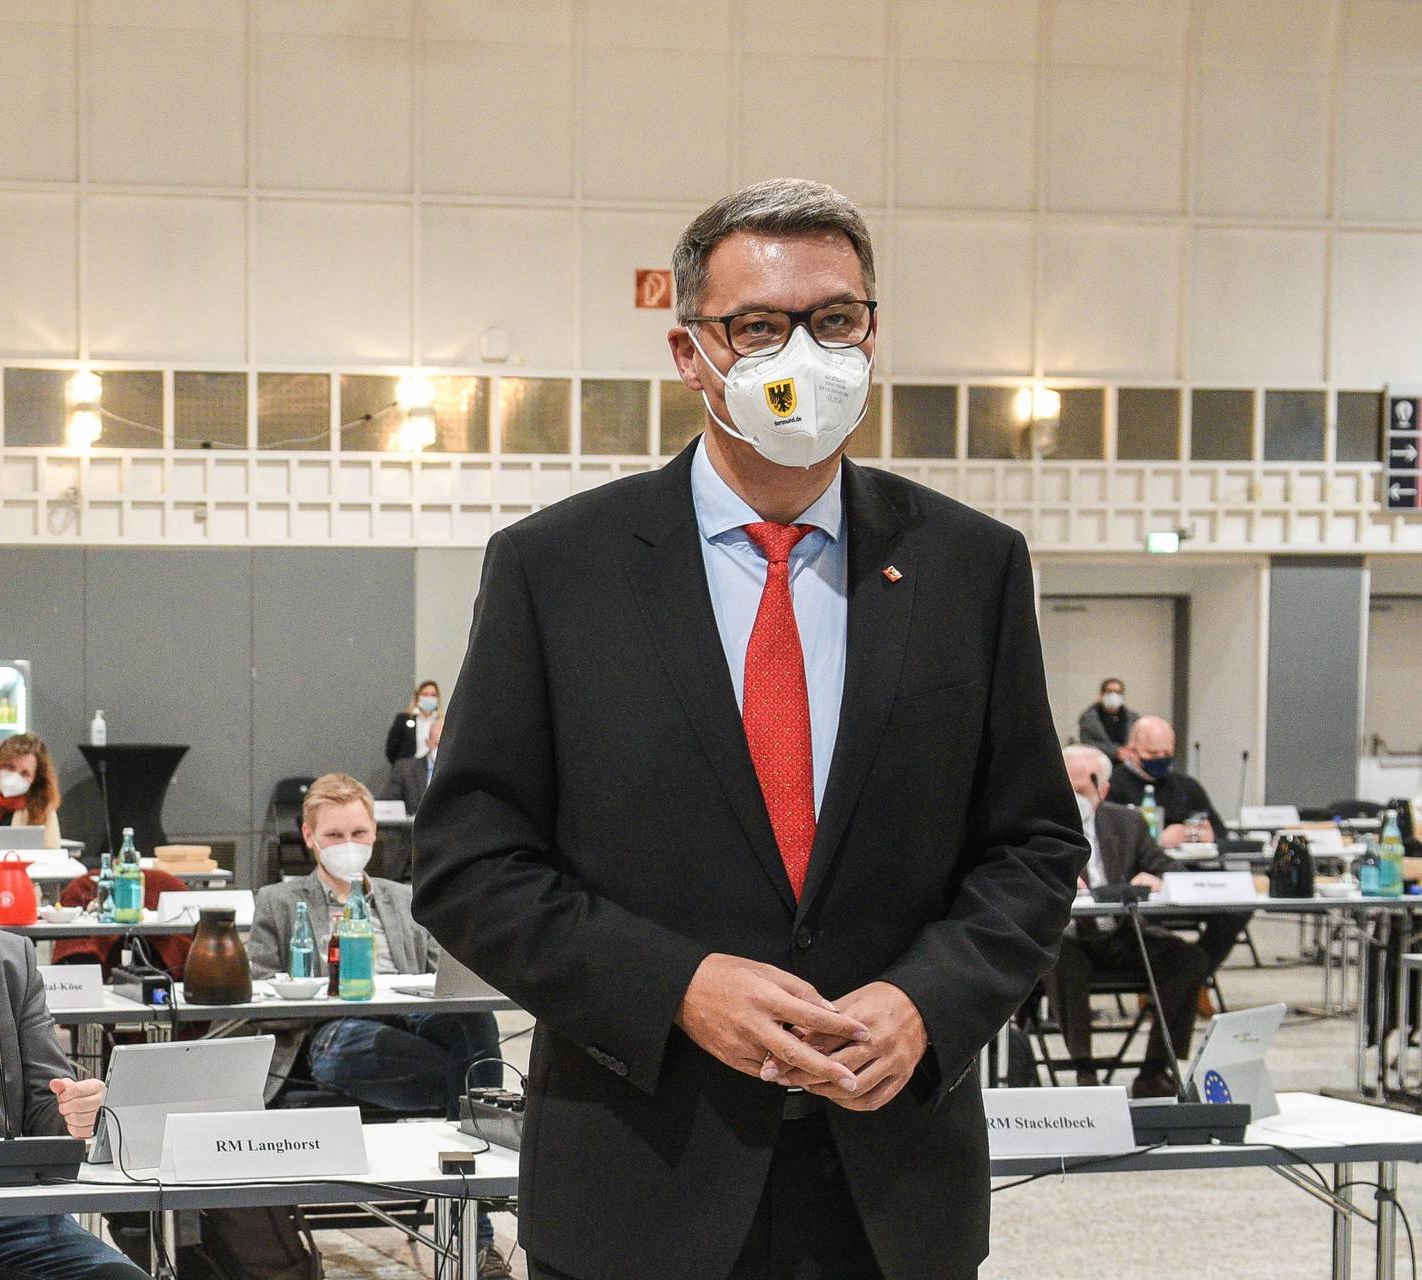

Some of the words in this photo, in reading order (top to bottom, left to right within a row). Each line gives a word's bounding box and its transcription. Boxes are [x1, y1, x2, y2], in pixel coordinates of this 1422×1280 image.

[986, 1117, 1011, 1129] RM
[1014, 1116, 1096, 1129] Stackelbeck
[216, 1139, 243, 1152] RM
[247, 1138, 321, 1154] Langhorst
